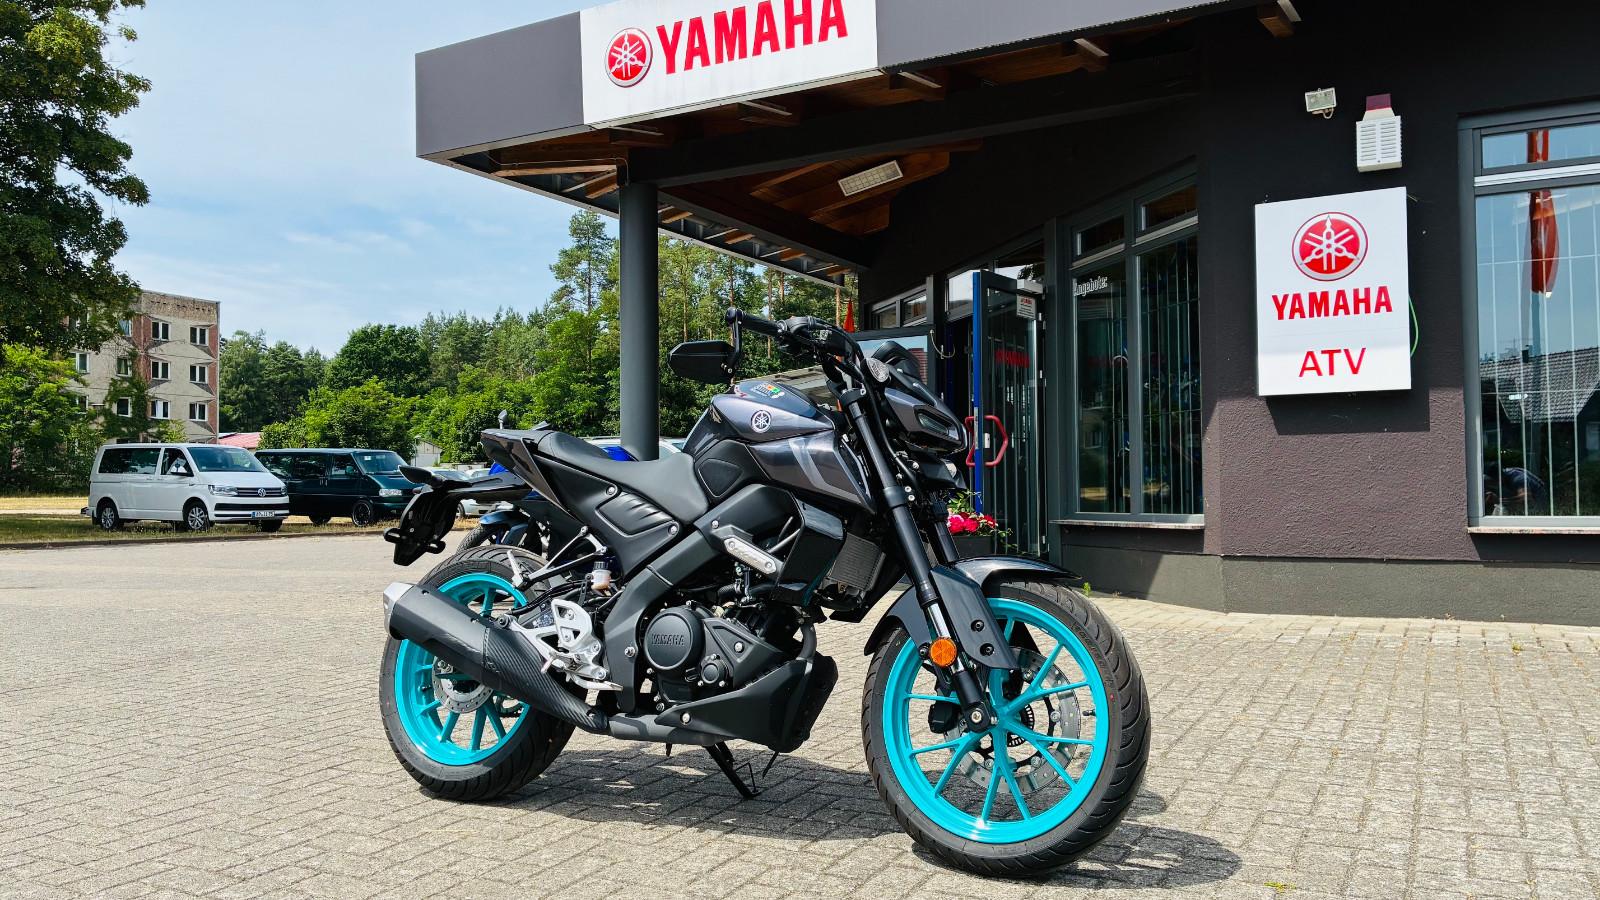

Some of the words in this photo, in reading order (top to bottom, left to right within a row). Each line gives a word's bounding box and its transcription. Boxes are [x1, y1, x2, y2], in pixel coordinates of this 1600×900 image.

[656, 0, 848, 75] YAMAHA
[1272, 286, 1393, 320] YAMAHA
[1299, 348, 1366, 377] ATV
[651, 633, 685, 646] YAMAHA
